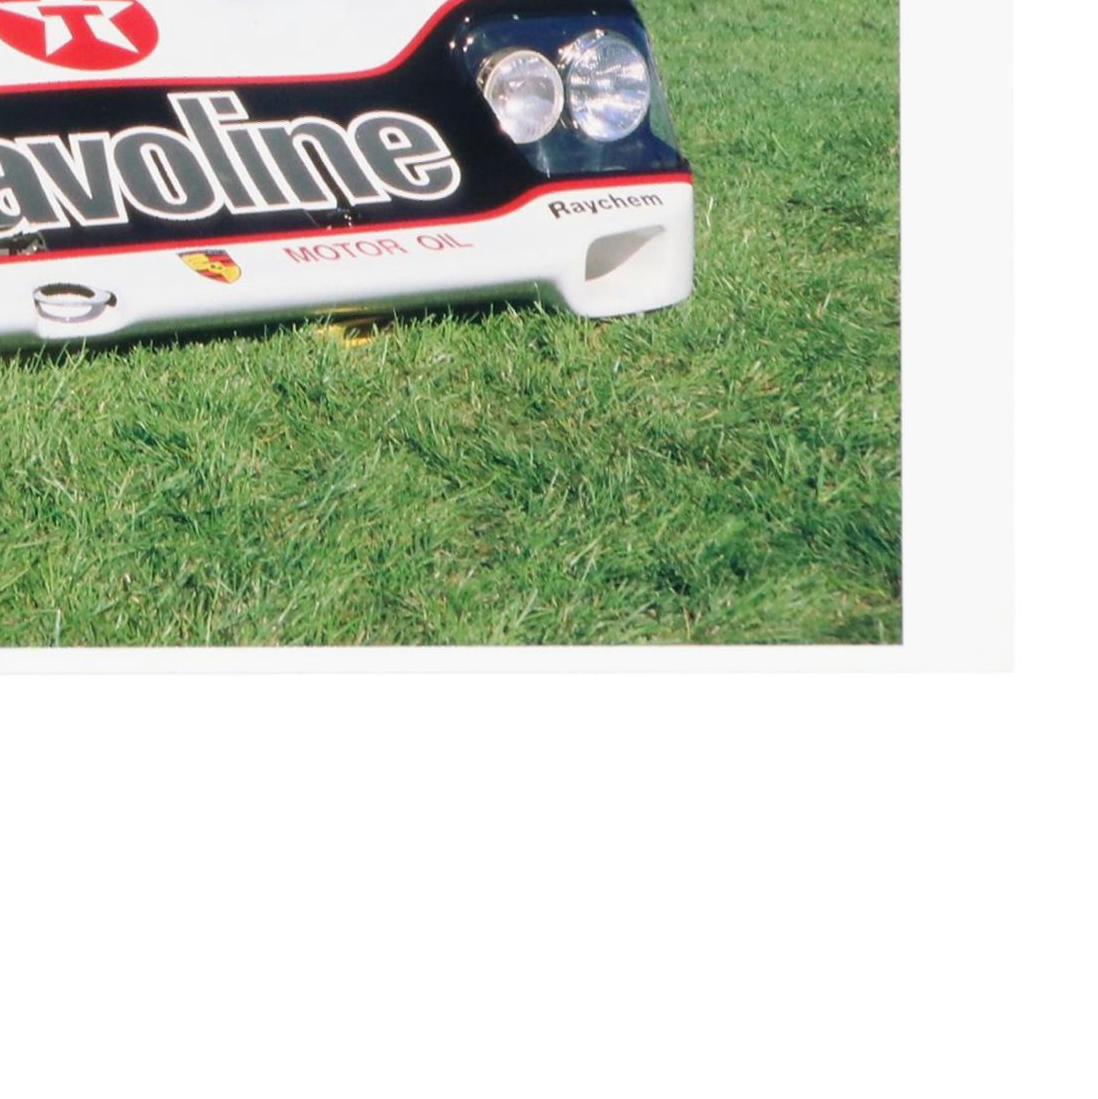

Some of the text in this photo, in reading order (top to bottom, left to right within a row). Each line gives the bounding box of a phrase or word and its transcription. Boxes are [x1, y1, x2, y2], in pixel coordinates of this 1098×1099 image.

[547, 191, 664, 219] Raychem
[283, 232, 475, 264] MOTOR OIL
